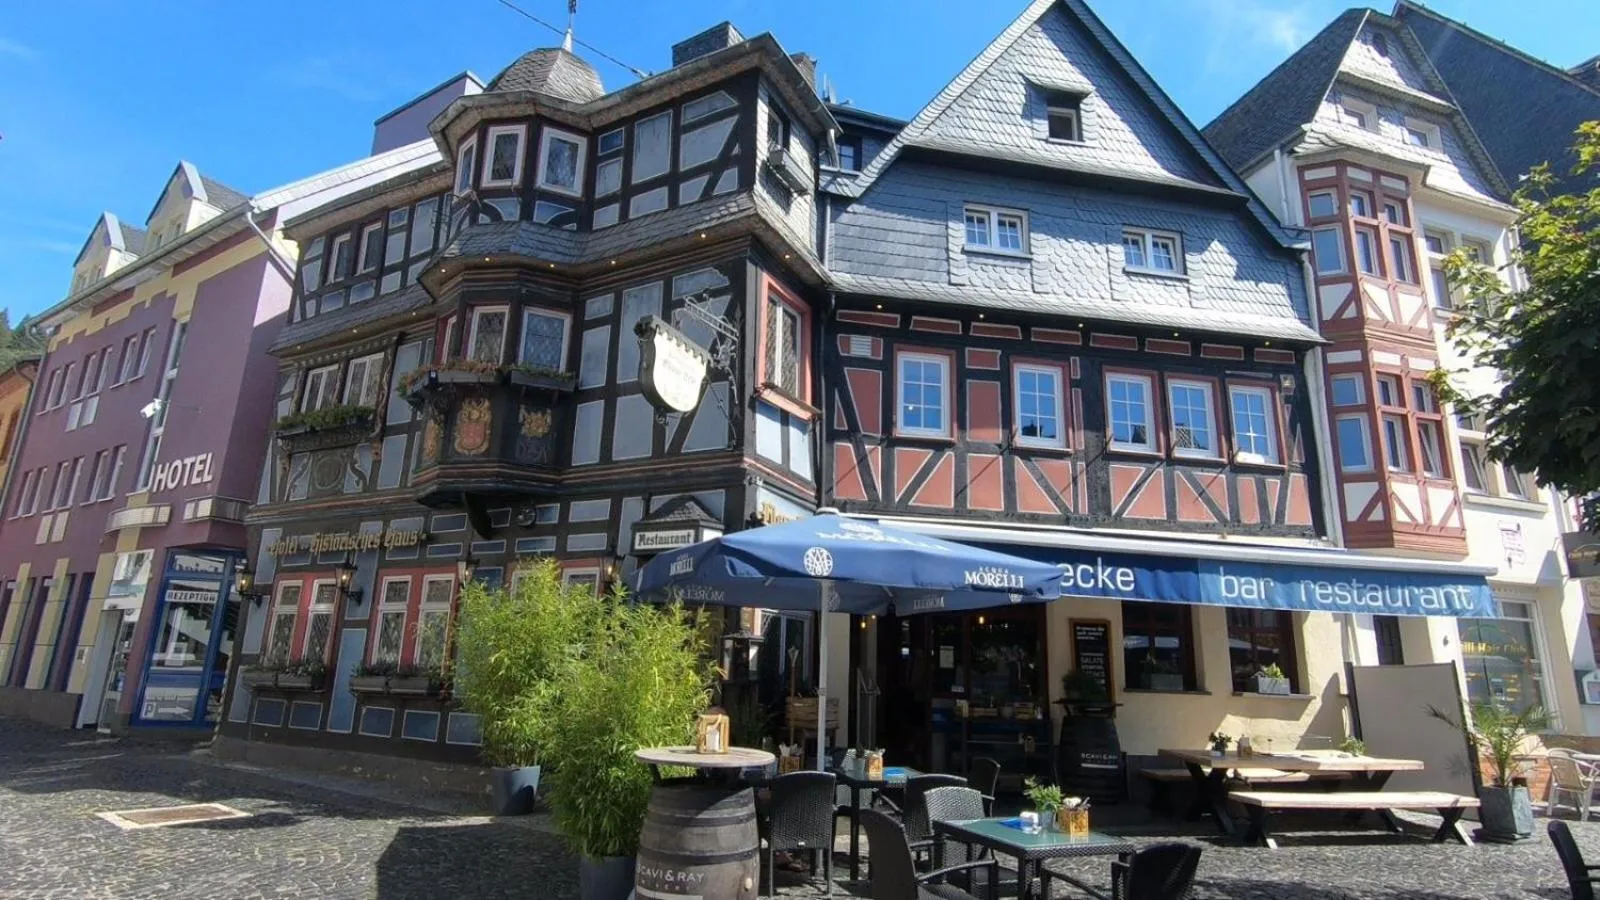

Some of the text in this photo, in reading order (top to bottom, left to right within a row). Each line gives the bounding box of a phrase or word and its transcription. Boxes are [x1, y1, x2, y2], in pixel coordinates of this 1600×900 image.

[153, 452, 213, 493] HOTEL
[637, 531, 692, 547] Restaurant
[964, 570, 1024, 589] MORELLI
[1219, 566, 1274, 601] bar
[1299, 578, 1475, 610] restaurant
[664, 869, 675, 882] &
[677, 871, 705, 883] RAY
